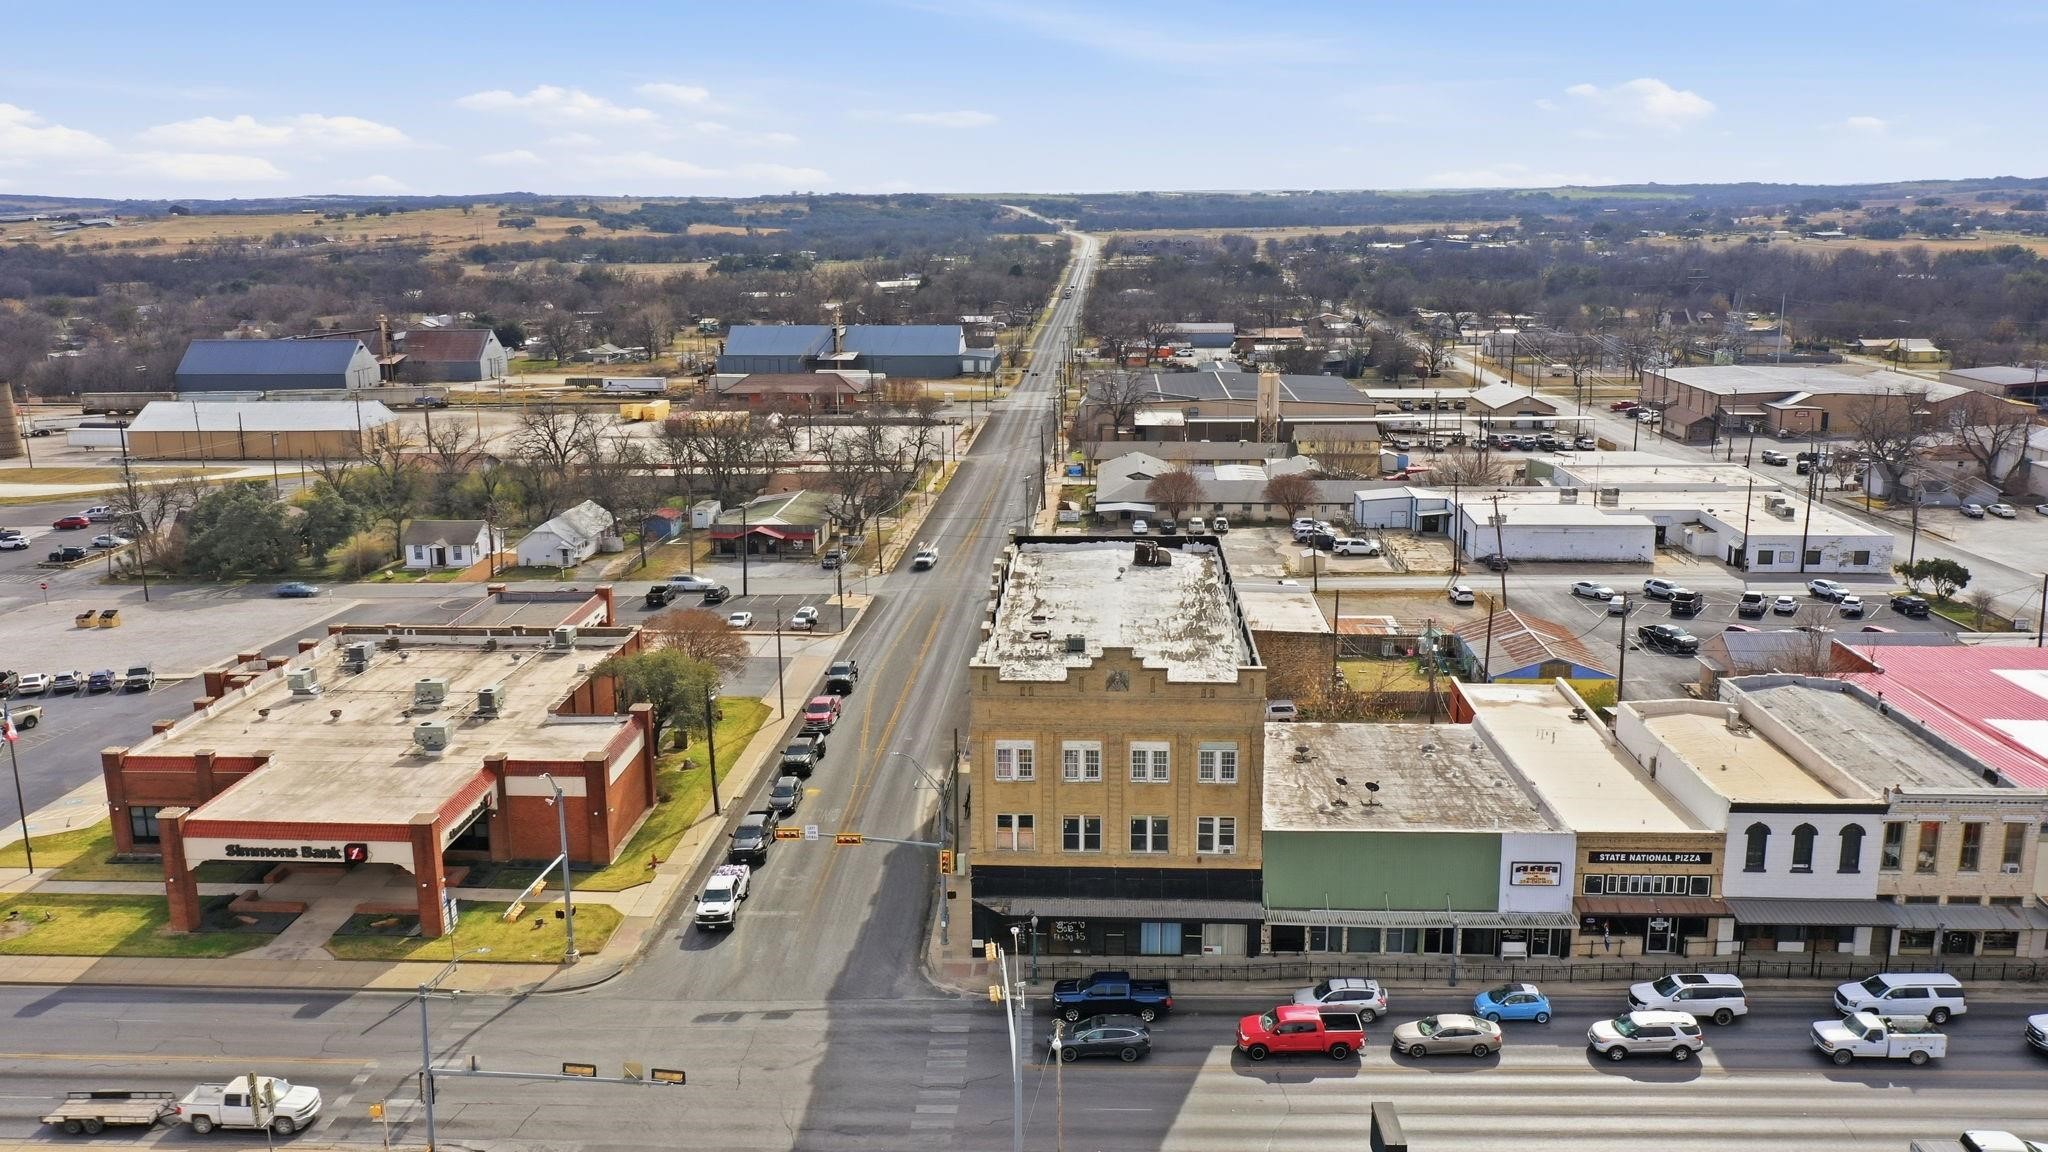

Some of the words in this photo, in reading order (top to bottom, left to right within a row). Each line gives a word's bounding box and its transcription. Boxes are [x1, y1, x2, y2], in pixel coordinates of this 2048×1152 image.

[225, 844, 298, 858] Simmons
[300, 846, 342, 859] Bank
[1600, 853, 1626, 861] STATE
[1629, 854, 1672, 862] NATIONAL
[1675, 854, 1701, 862] PIZZA
[1515, 865, 1558, 873] AAA
